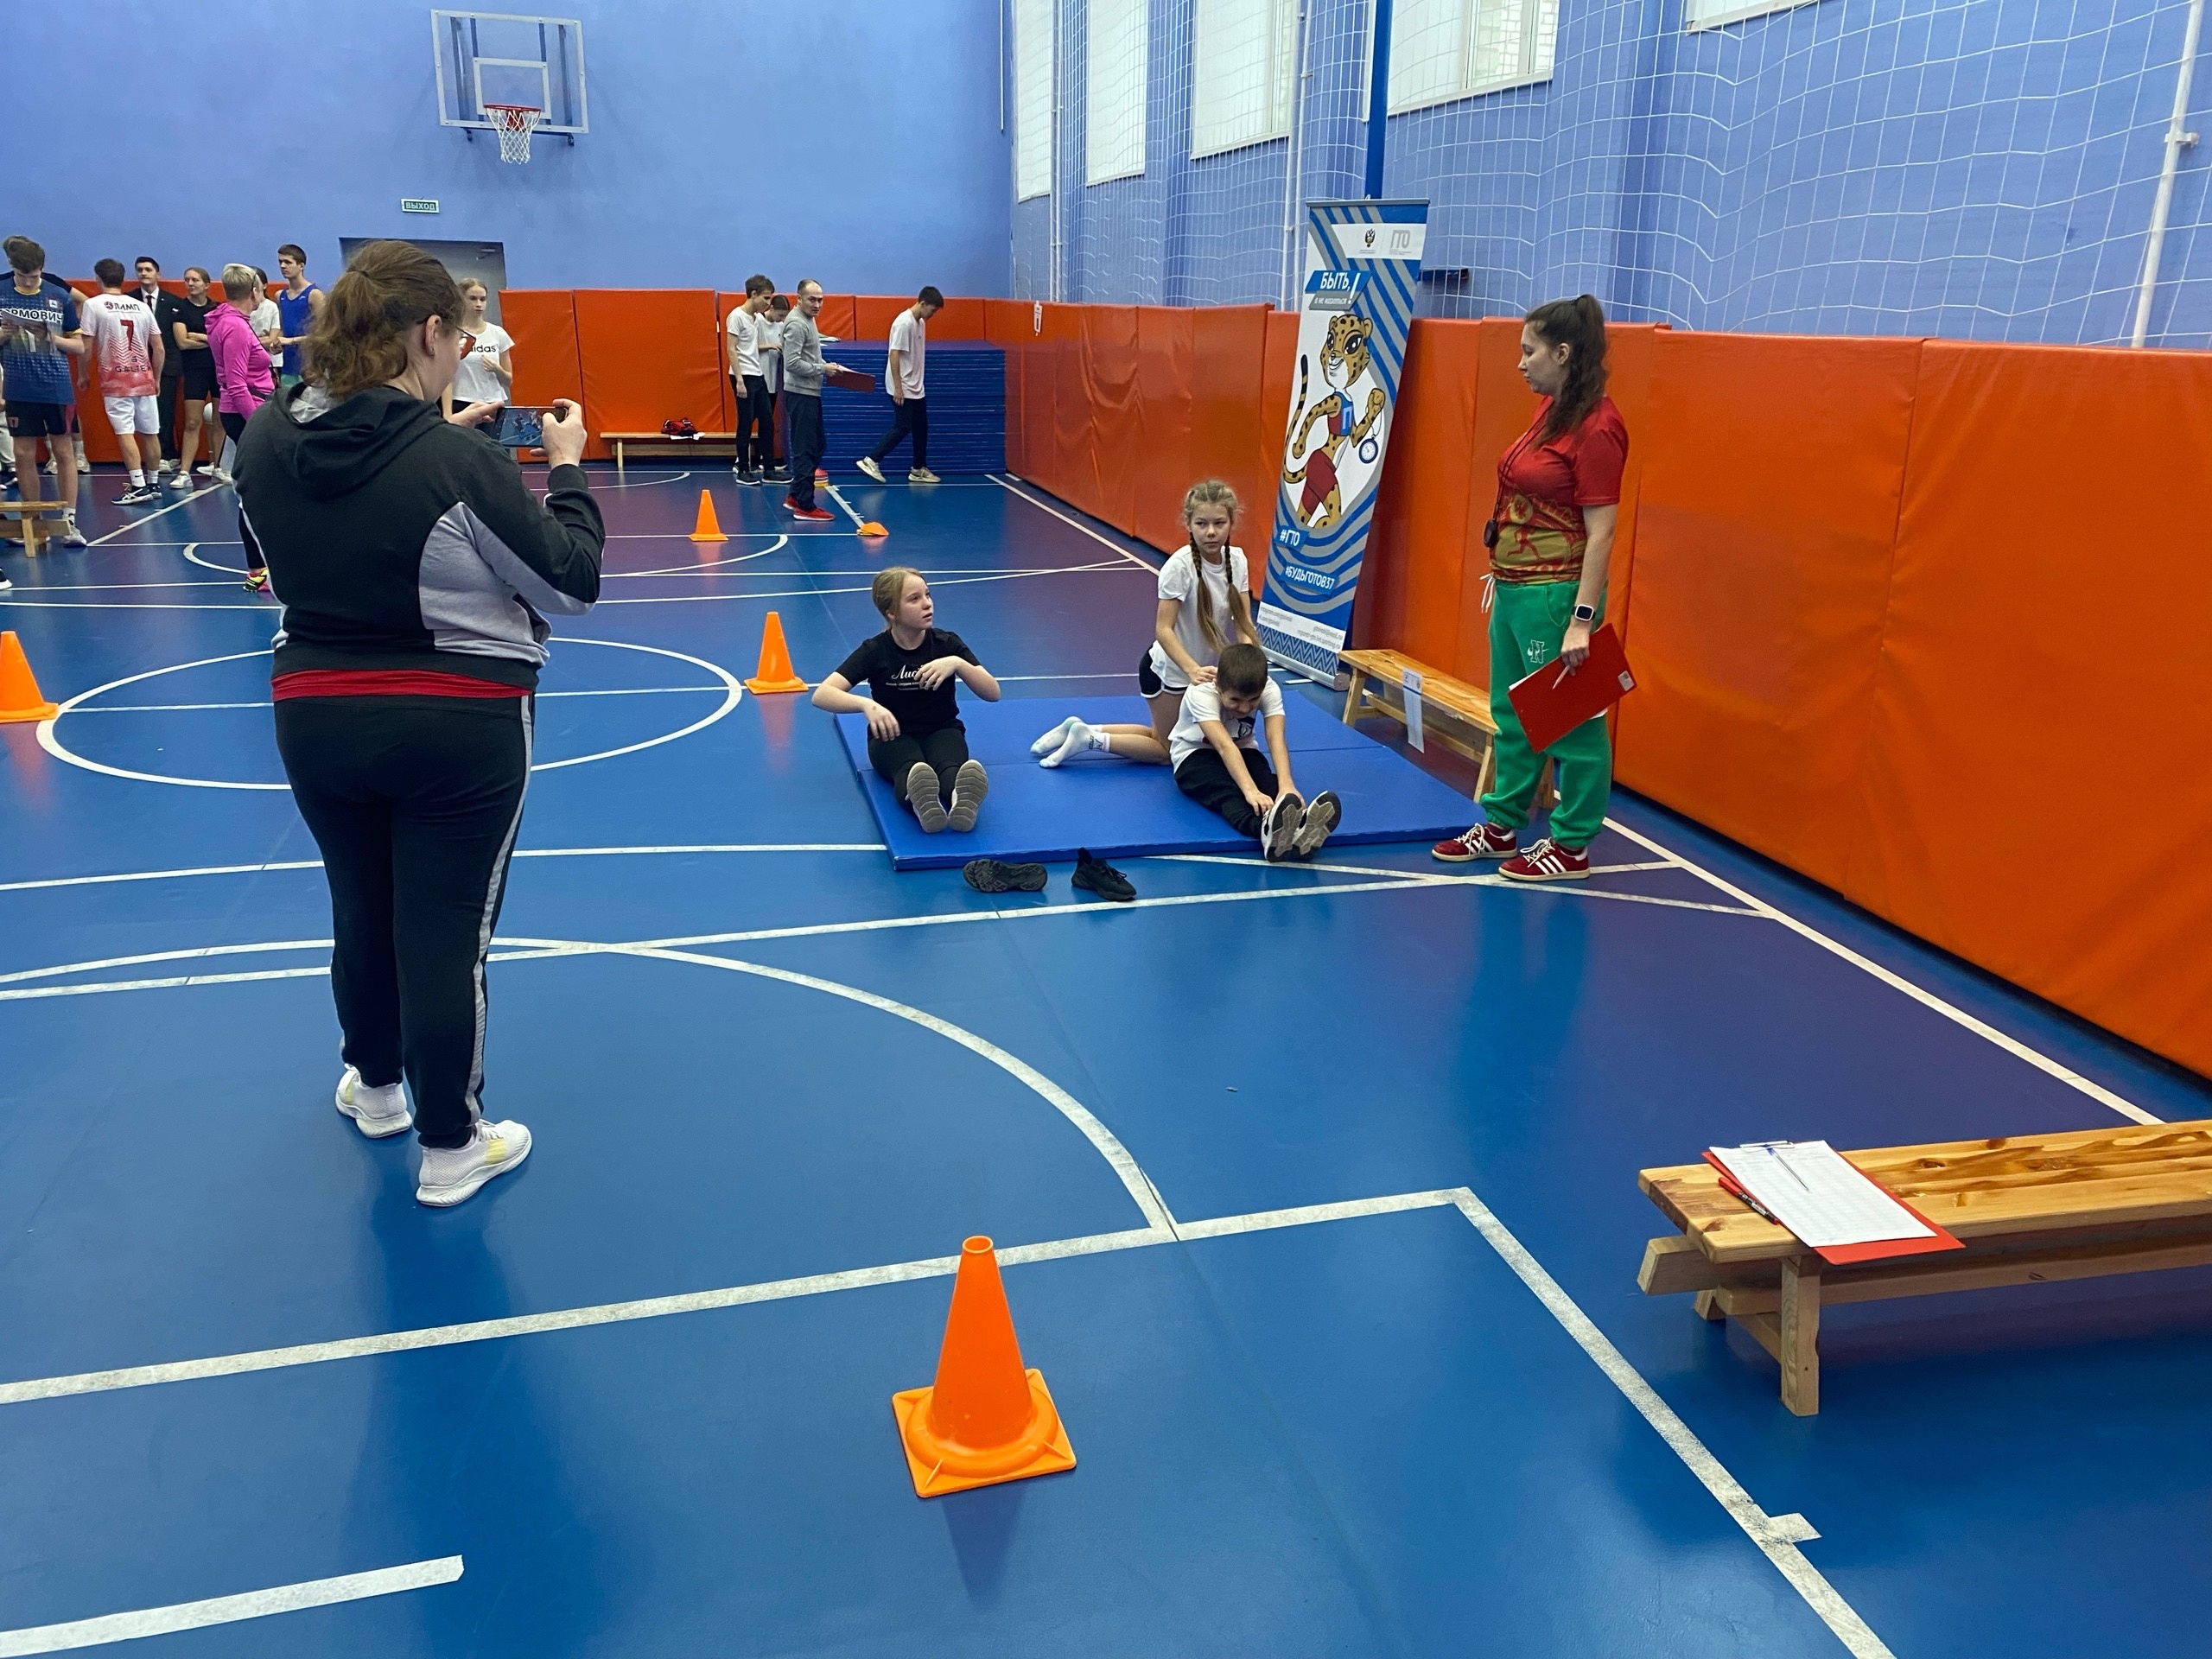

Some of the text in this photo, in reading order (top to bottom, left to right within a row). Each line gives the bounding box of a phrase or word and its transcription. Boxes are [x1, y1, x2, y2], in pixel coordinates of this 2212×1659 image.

[405, 201, 435, 211] ВЫХОД
[0, 307, 64, 324] РМОВИЧ
[120, 320, 134, 351] 7
[1280, 529, 1300, 546] #ГТО
[1285, 565, 1335, 589] #БУДЬГОТОВ37
